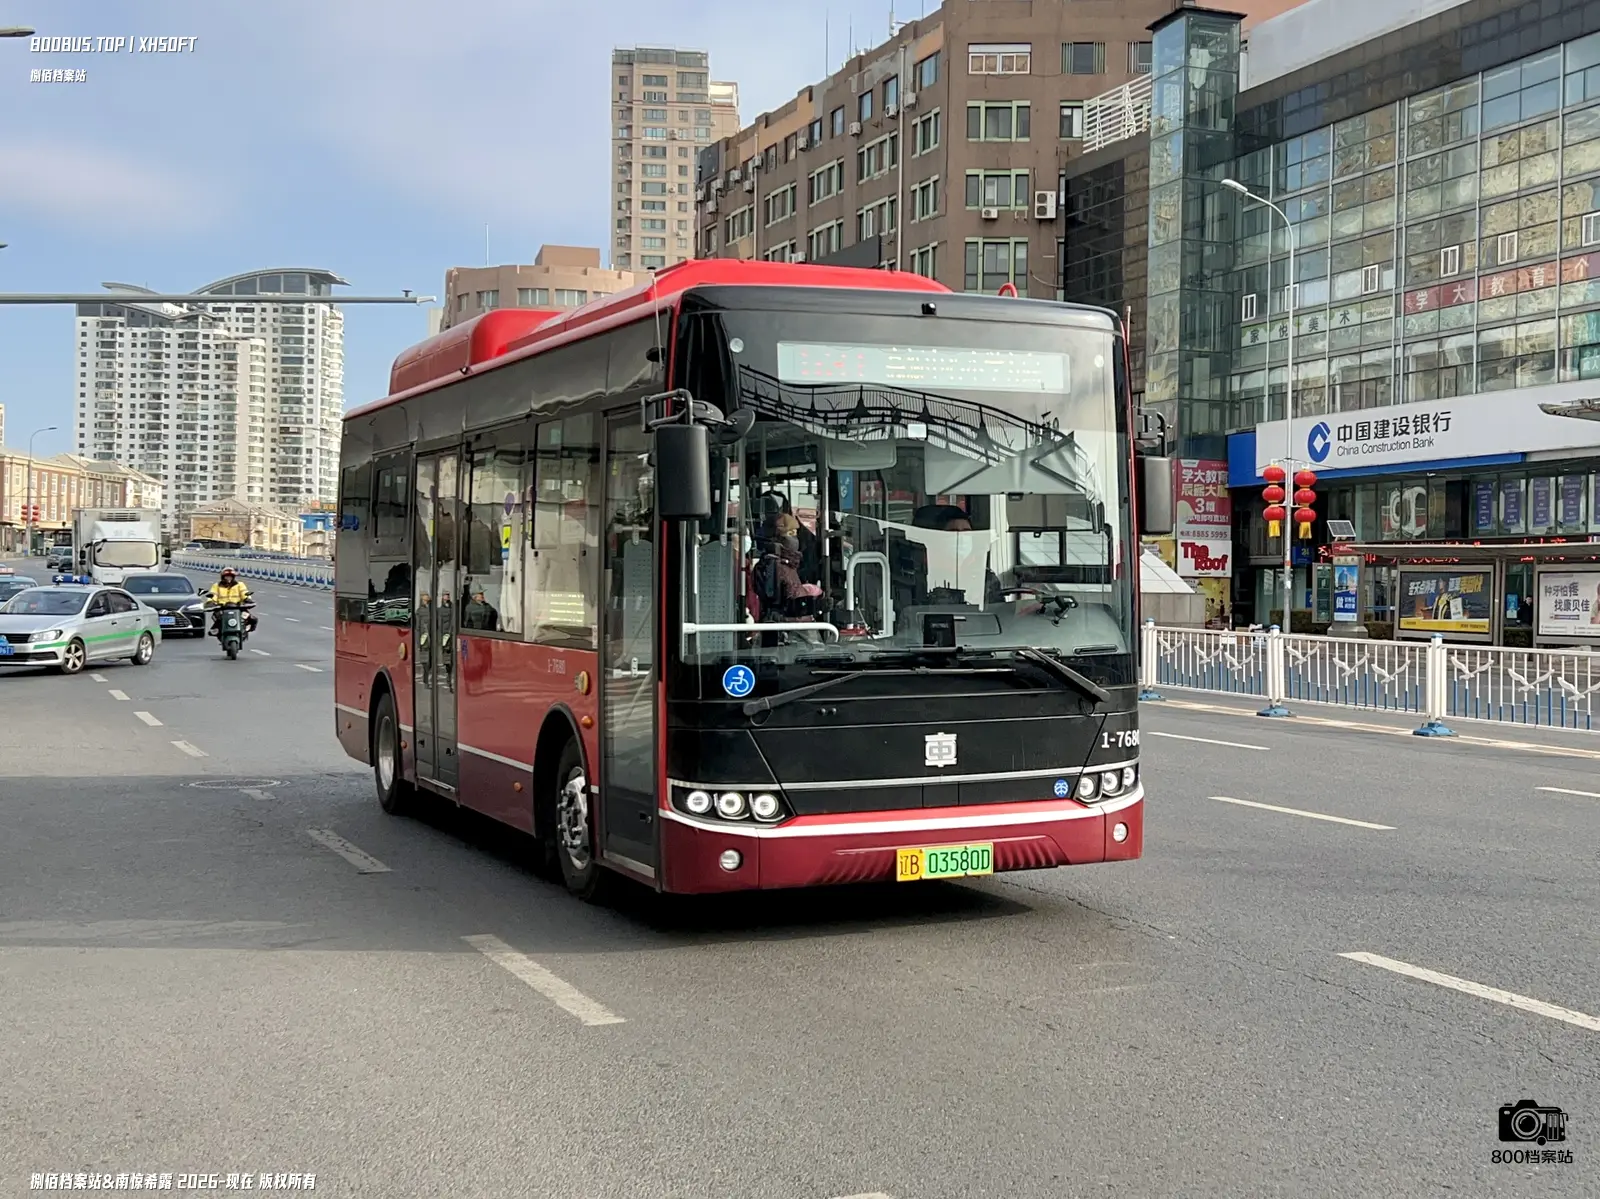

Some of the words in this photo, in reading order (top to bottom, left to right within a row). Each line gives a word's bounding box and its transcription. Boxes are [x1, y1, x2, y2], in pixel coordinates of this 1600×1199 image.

[1337, 411, 1452, 443] 中国建设银行
[1336, 444, 1360, 457] China
[1361, 439, 1411, 454] Construction
[1412, 436, 1435, 449] Bank
[1181, 542, 1210, 559] The
[1194, 554, 1229, 571] Roof
[900, 854, 920, 876] 辽B
[928, 849, 990, 873] 03580D
